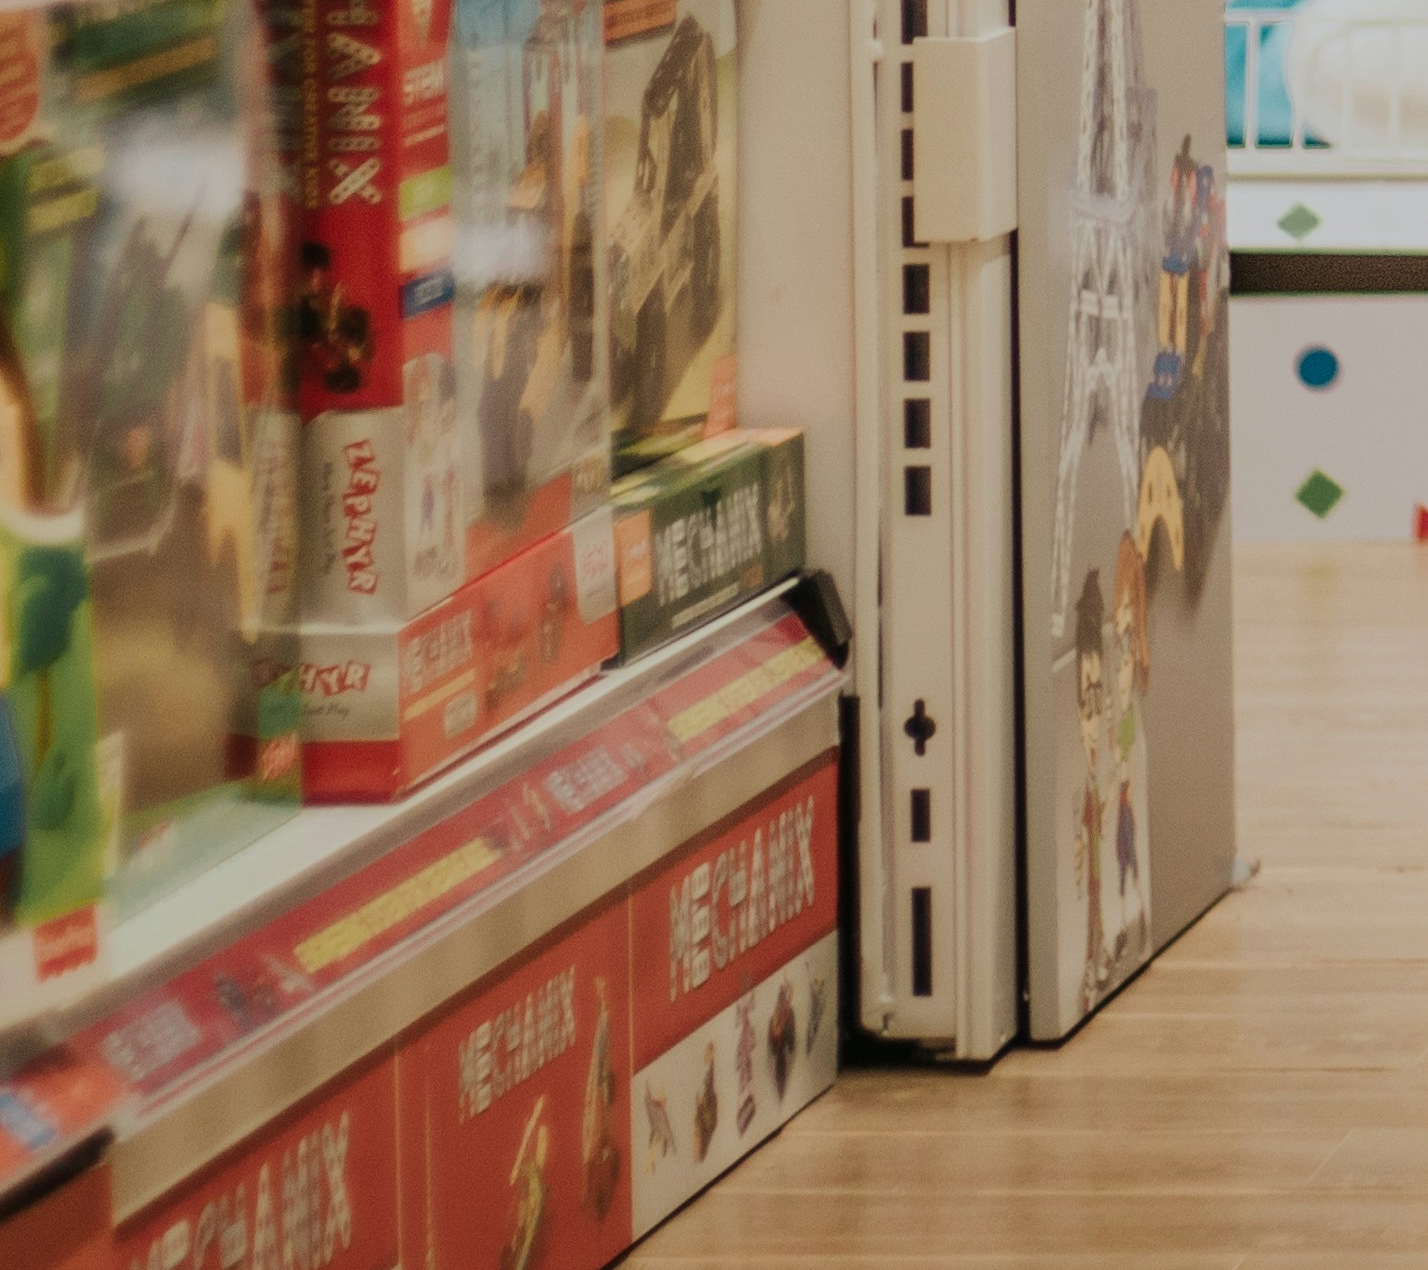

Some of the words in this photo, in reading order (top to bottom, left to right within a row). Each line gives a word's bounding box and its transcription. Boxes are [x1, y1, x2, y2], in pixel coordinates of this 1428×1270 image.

[342, 438, 380, 596] ZEPHYR
[655, 481, 763, 606] MECHANIX
[668, 794, 817, 1004] MECHANIX
[458, 966, 577, 1125] MECHANIX
